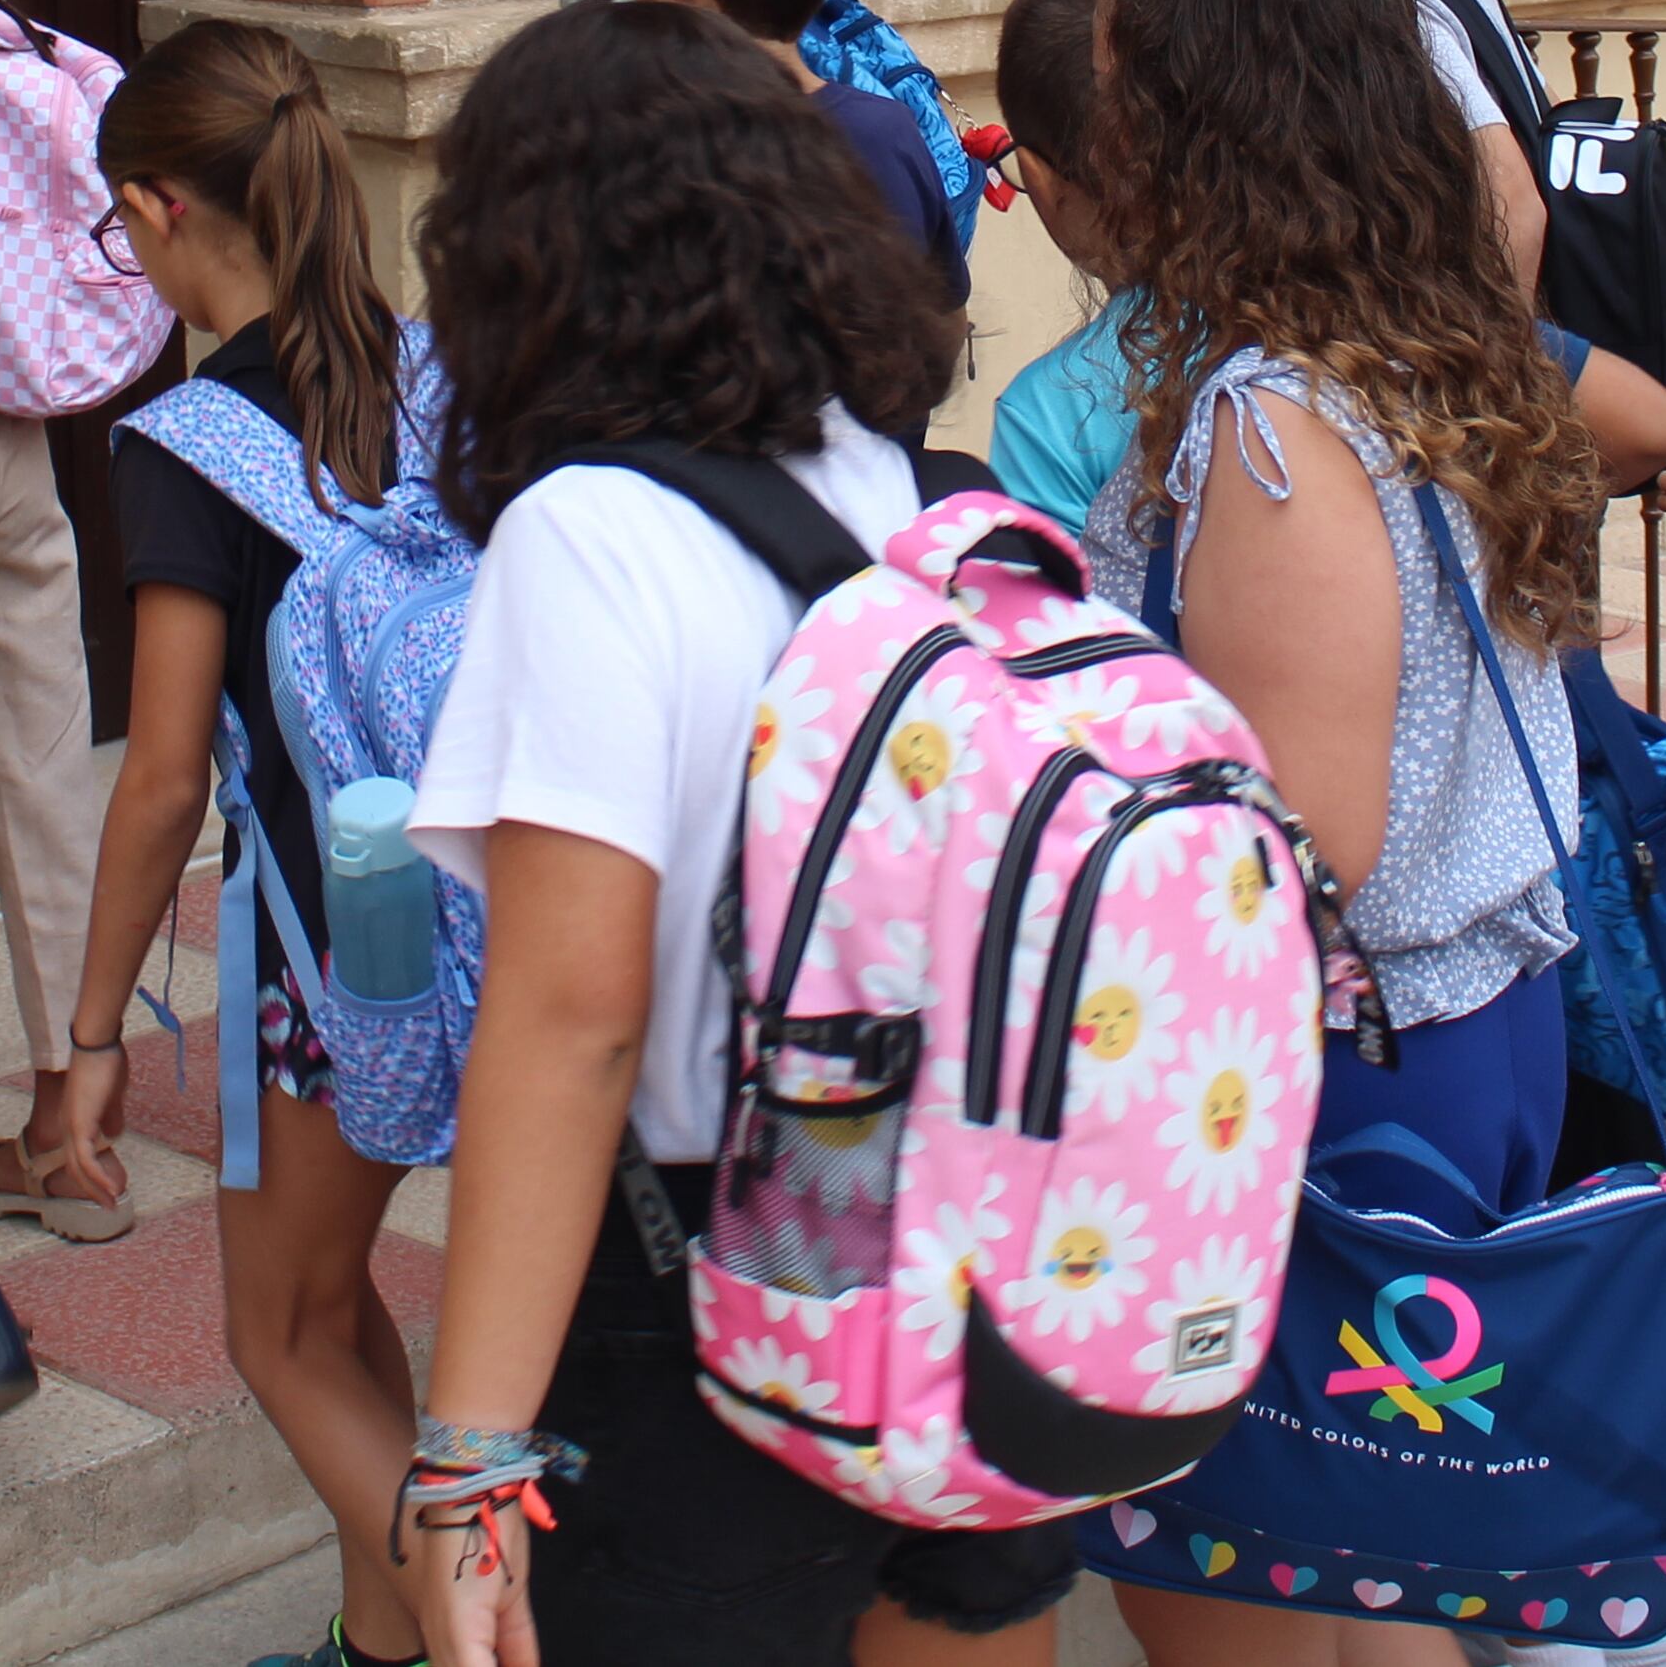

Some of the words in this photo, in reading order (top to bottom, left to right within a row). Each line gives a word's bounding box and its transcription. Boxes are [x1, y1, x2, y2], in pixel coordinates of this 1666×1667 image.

[1244, 1401, 1301, 1430] NITED
[1312, 1427, 1389, 1458] COLORS
[1400, 1450, 1427, 1465] OF
[1437, 1454, 1475, 1472] THE
[1486, 1456, 1550, 1475] WORLD
